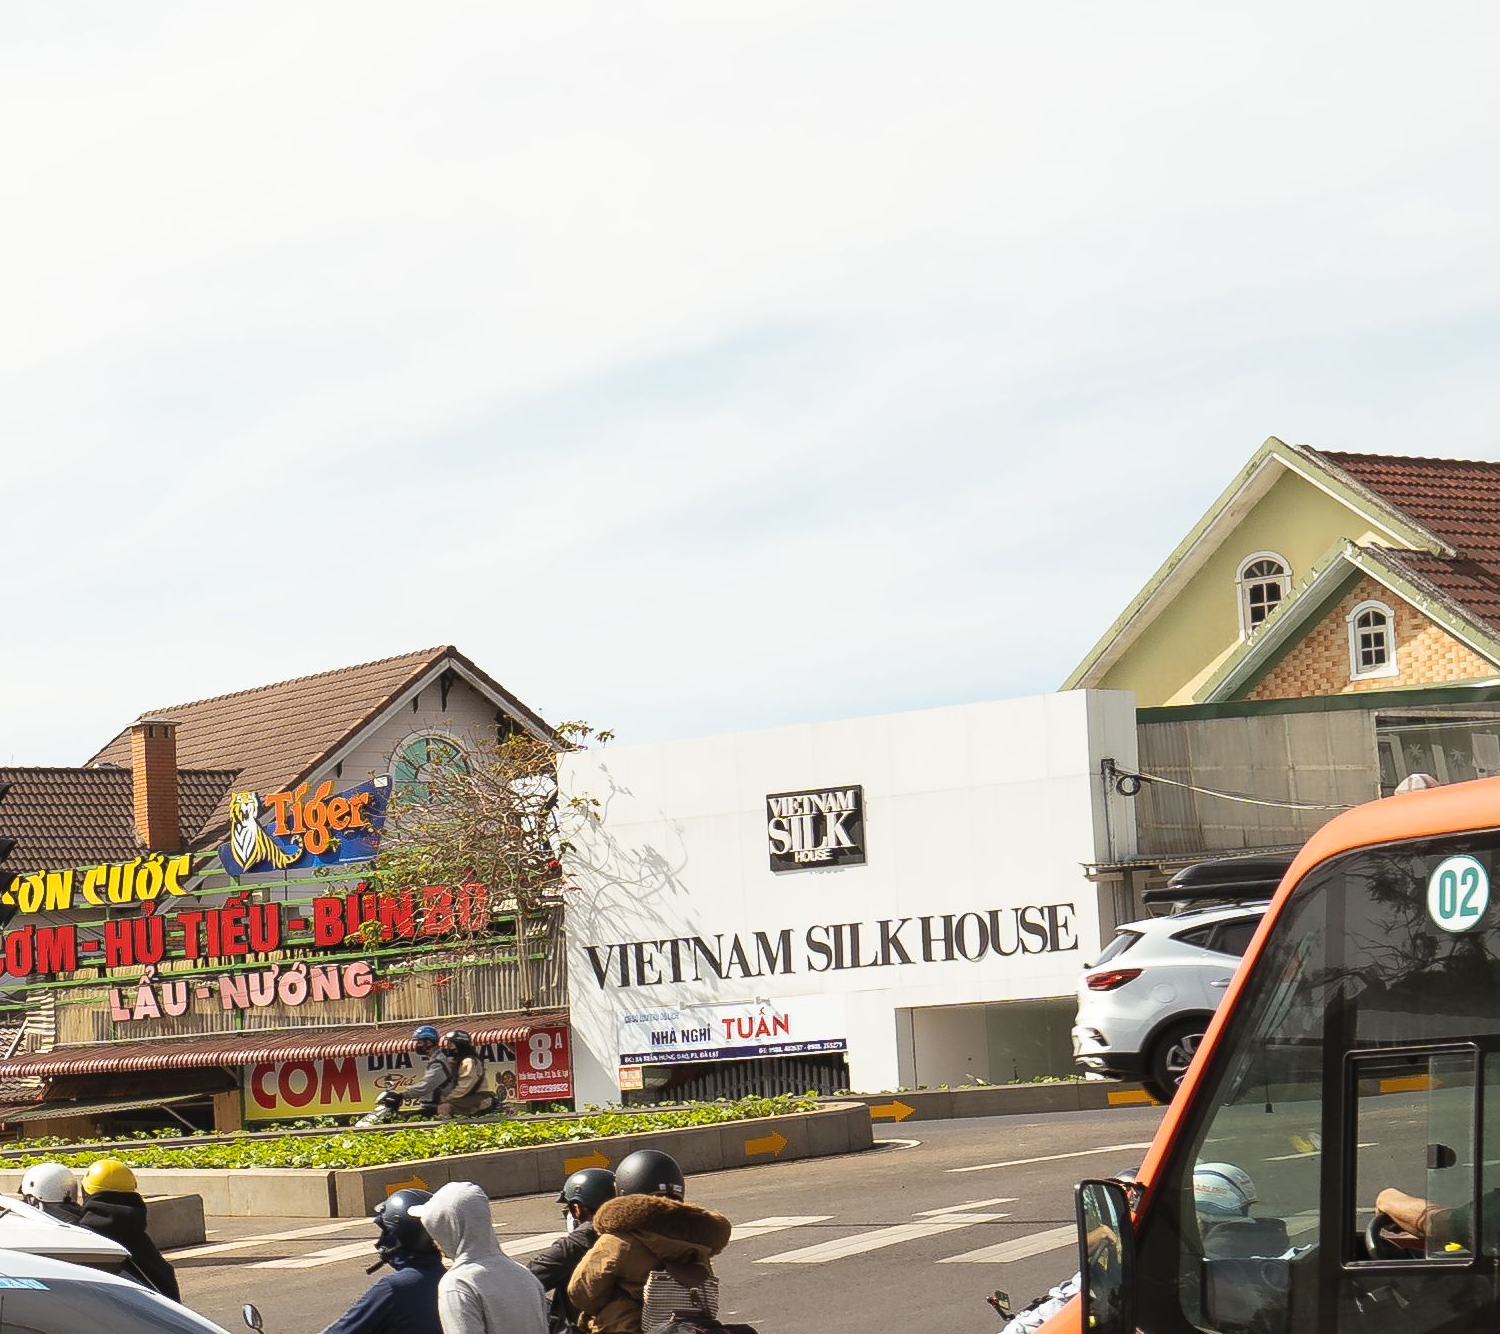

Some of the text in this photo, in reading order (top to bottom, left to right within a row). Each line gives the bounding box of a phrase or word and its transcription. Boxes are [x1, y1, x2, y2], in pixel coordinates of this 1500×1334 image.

[265, 780, 369, 855] Tiger
[767, 790, 859, 817] VIETNAM
[768, 810, 859, 855] SILK
[794, 848, 834, 863] HOUSE
[82, 853, 193, 905] CƯỚC
[1439, 866, 1479, 919] 02
[103, 901, 165, 968] HỦ
[177, 890, 281, 960] TIẾU
[582, 903, 1079, 990] VIETNAM SILK HOUSE
[108, 961, 373, 1022] LẨU NƯỚNG
[651, 1007, 790, 1045] NHÀ NGHỈ TUẤN
